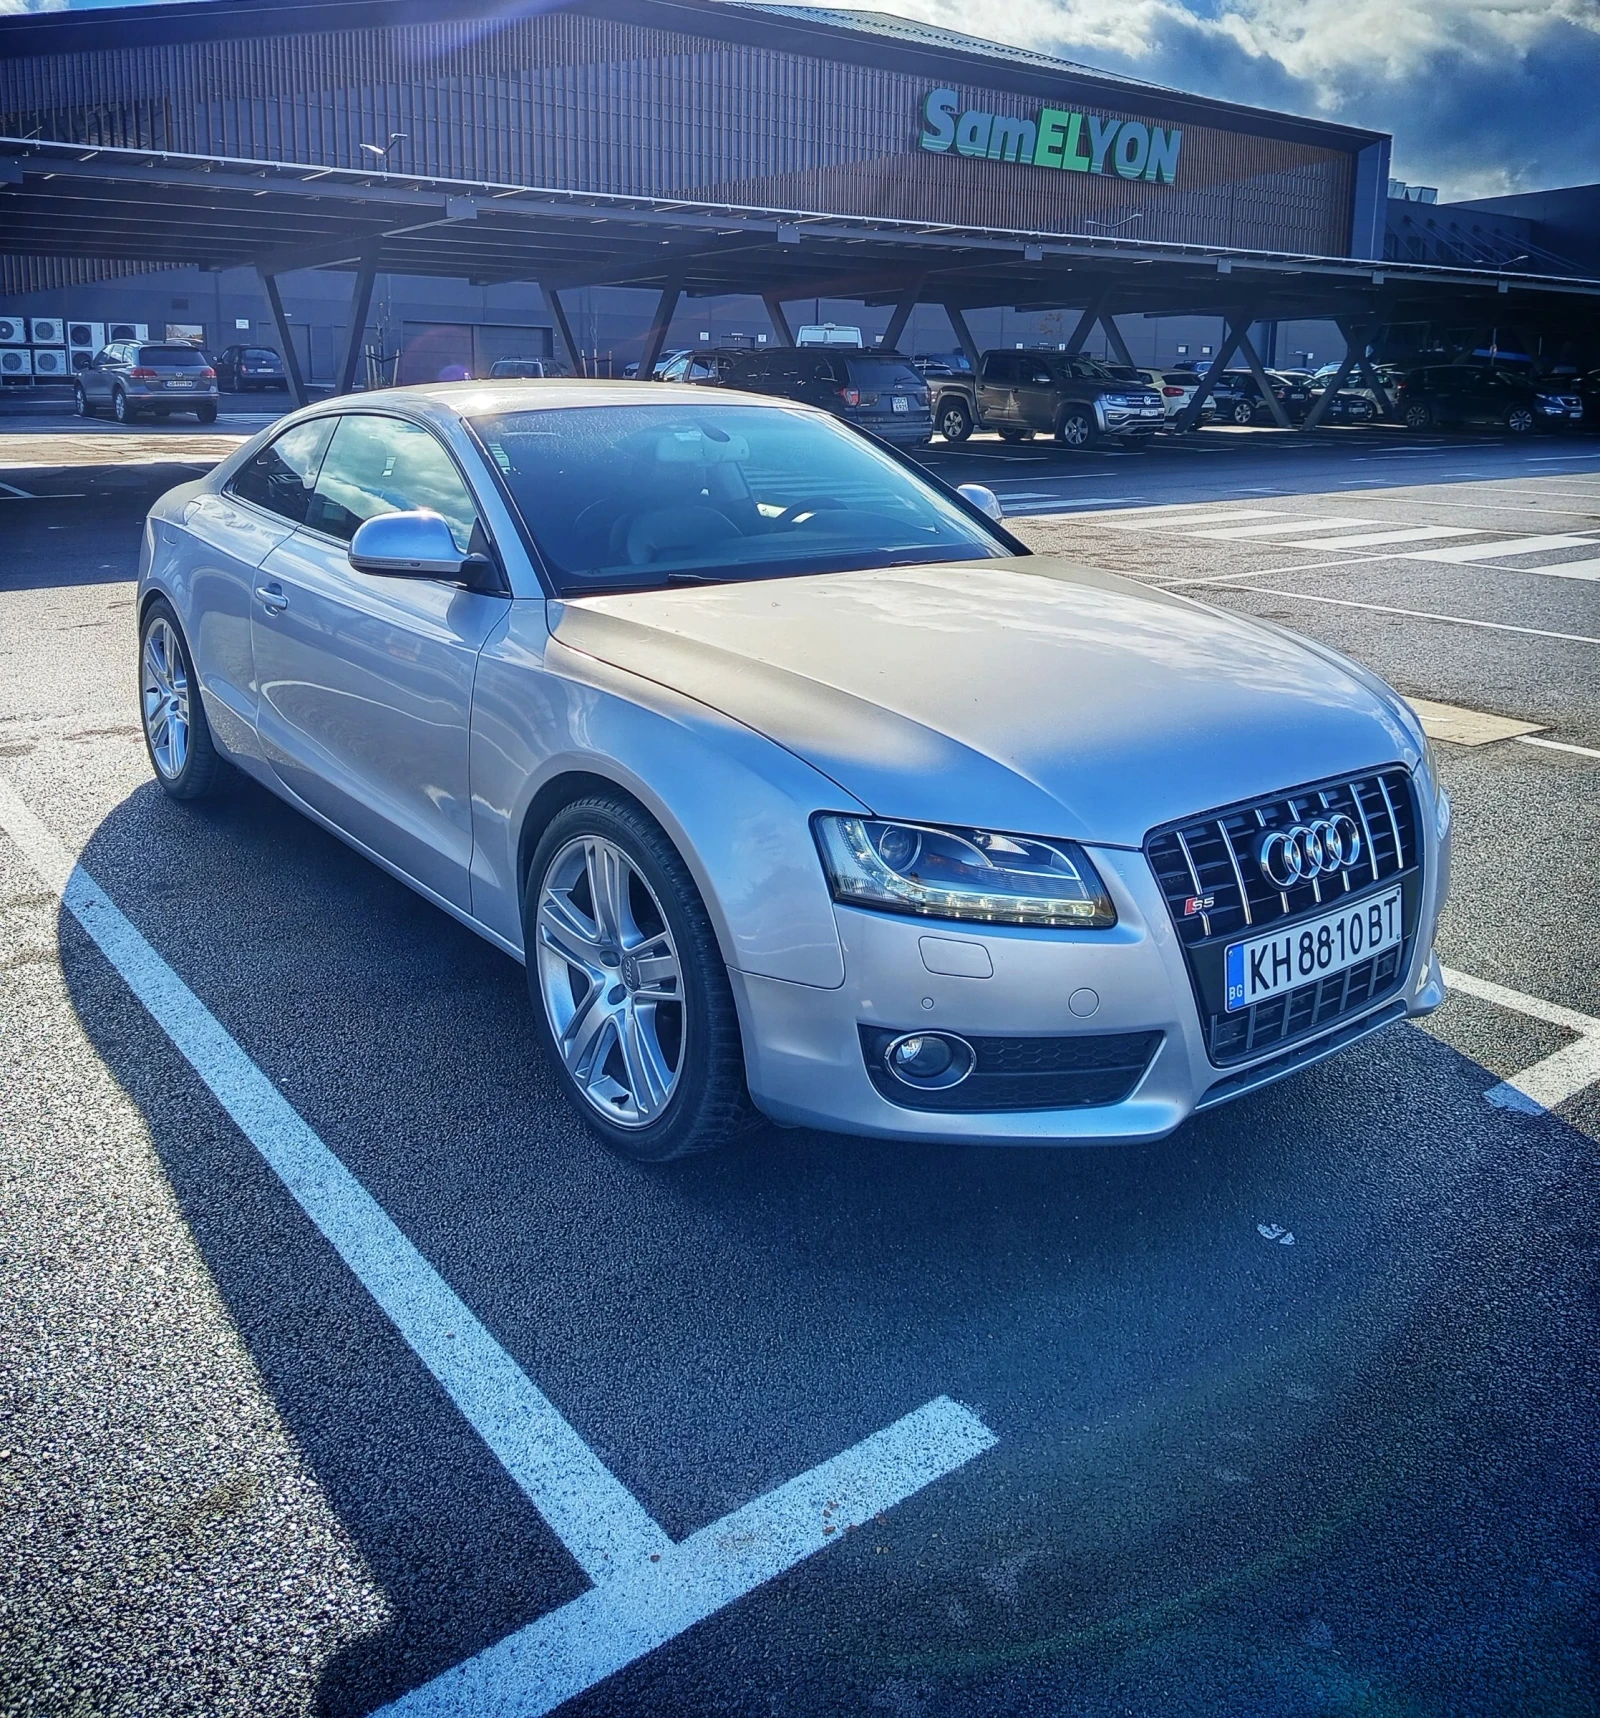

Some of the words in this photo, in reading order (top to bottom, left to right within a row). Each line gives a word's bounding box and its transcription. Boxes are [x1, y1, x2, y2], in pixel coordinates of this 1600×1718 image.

[920, 87, 1182, 184] SamELYON
[1192, 896, 1215, 911] S5
[1229, 983, 1244, 999] BG
